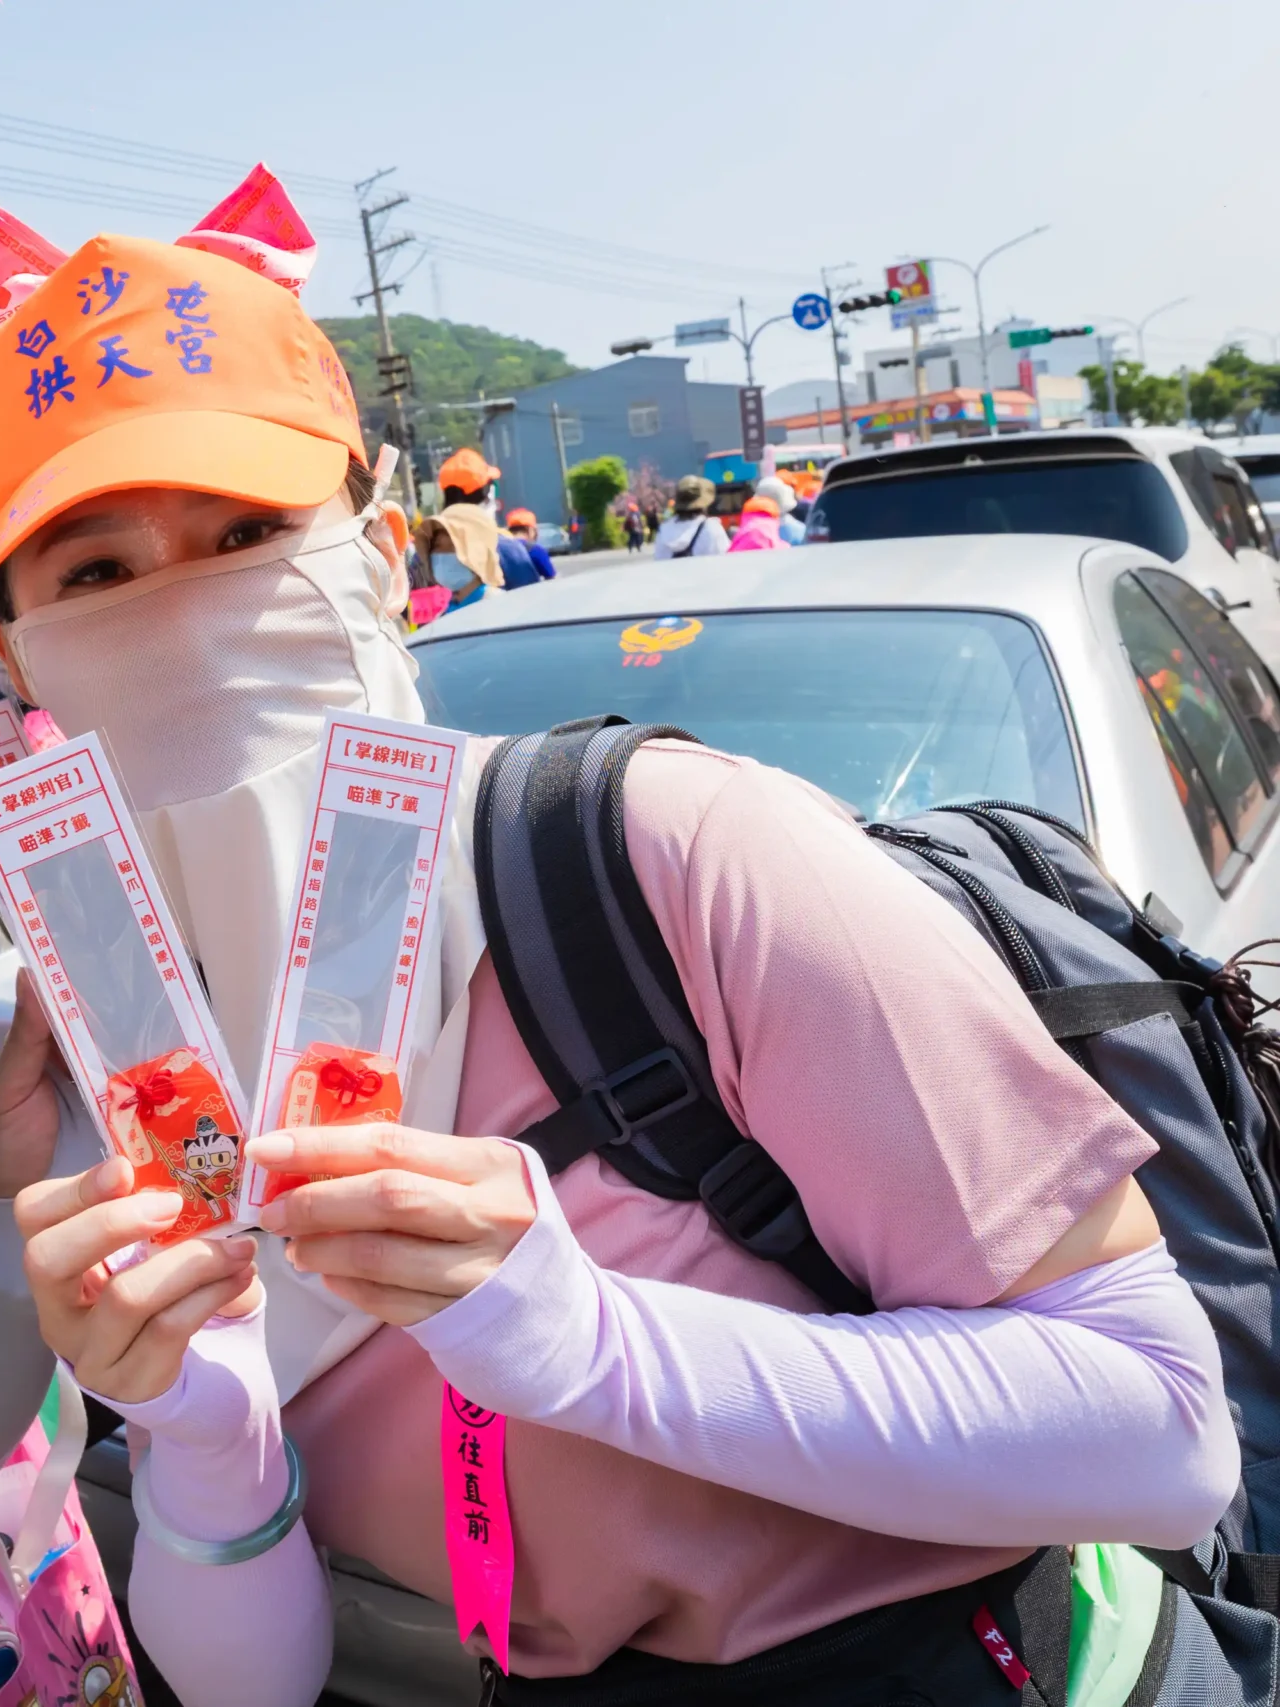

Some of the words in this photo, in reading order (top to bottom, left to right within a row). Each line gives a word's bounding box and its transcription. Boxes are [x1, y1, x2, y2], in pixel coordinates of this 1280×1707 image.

[25, 323, 217, 418] 拱天宮
[622, 653, 662, 668] 119
[347, 785, 419, 813] 喵準了籤
[18, 812, 91, 853] 喵準了籤
[293, 840, 328, 969] 喵眼指路在面前
